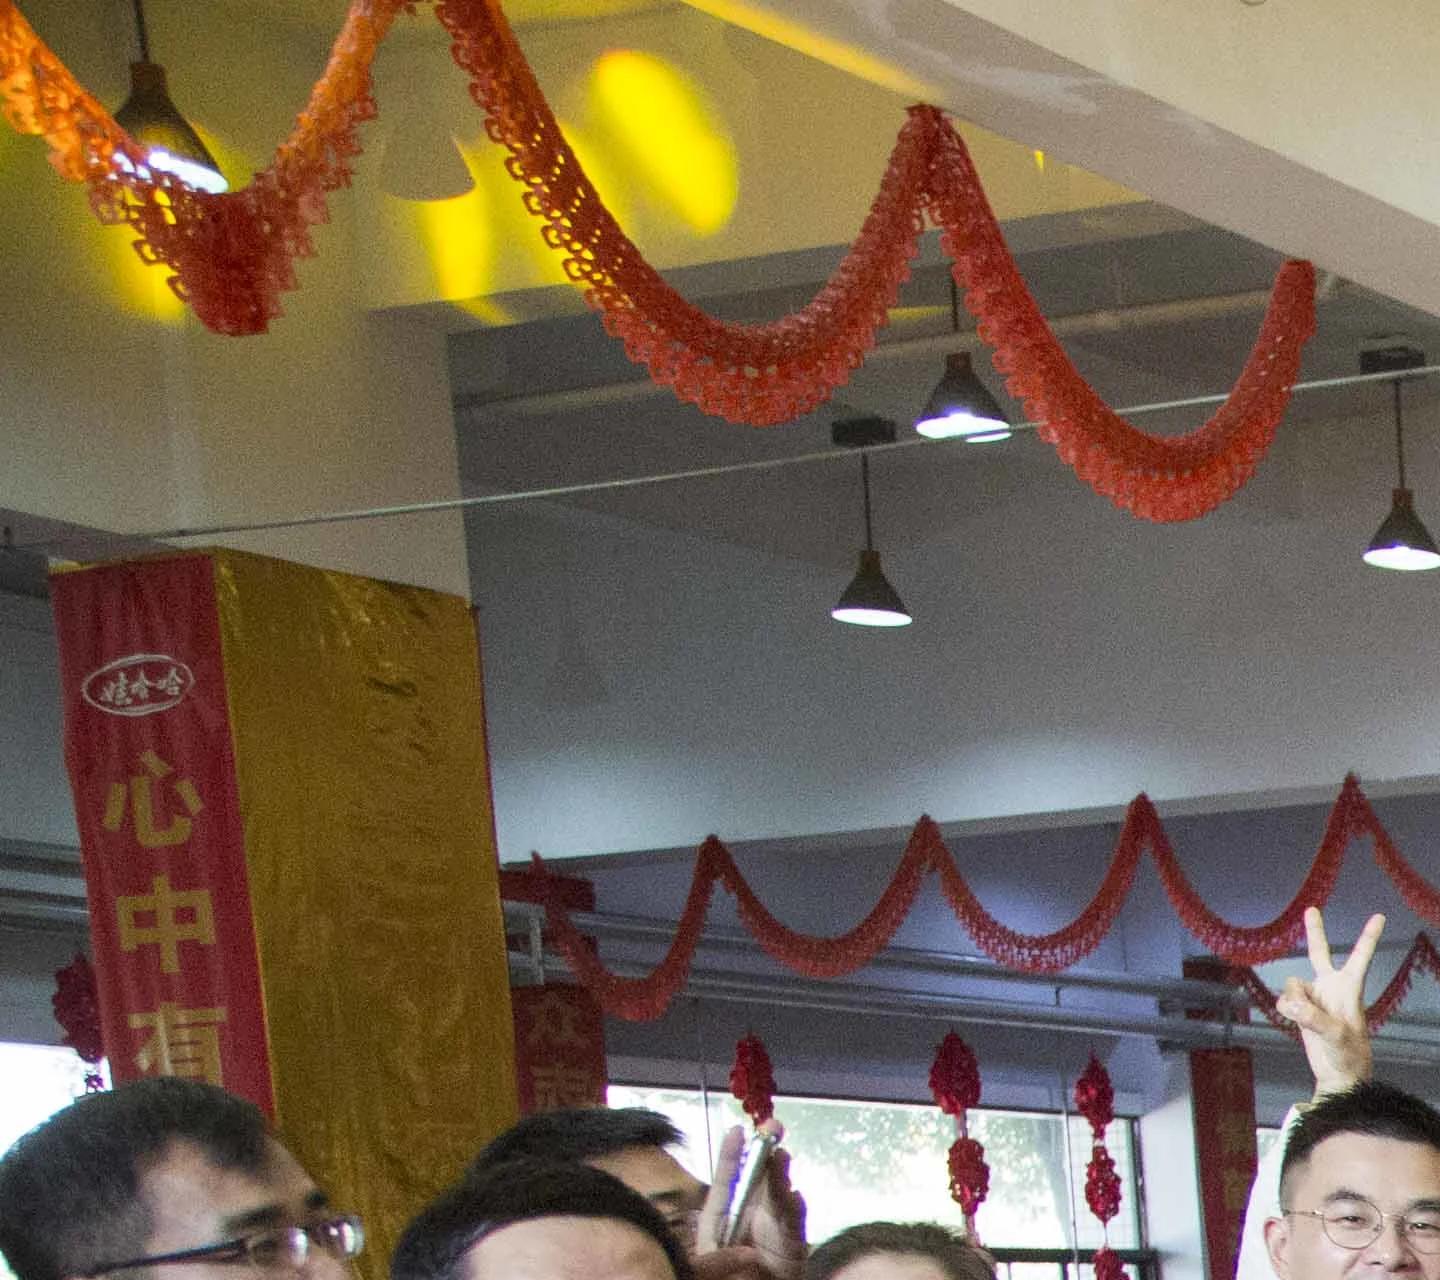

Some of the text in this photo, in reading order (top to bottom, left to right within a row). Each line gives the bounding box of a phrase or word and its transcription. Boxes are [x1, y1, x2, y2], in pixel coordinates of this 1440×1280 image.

[101, 664, 184, 706] 娃哈哈
[102, 749, 227, 1085] 心中有
